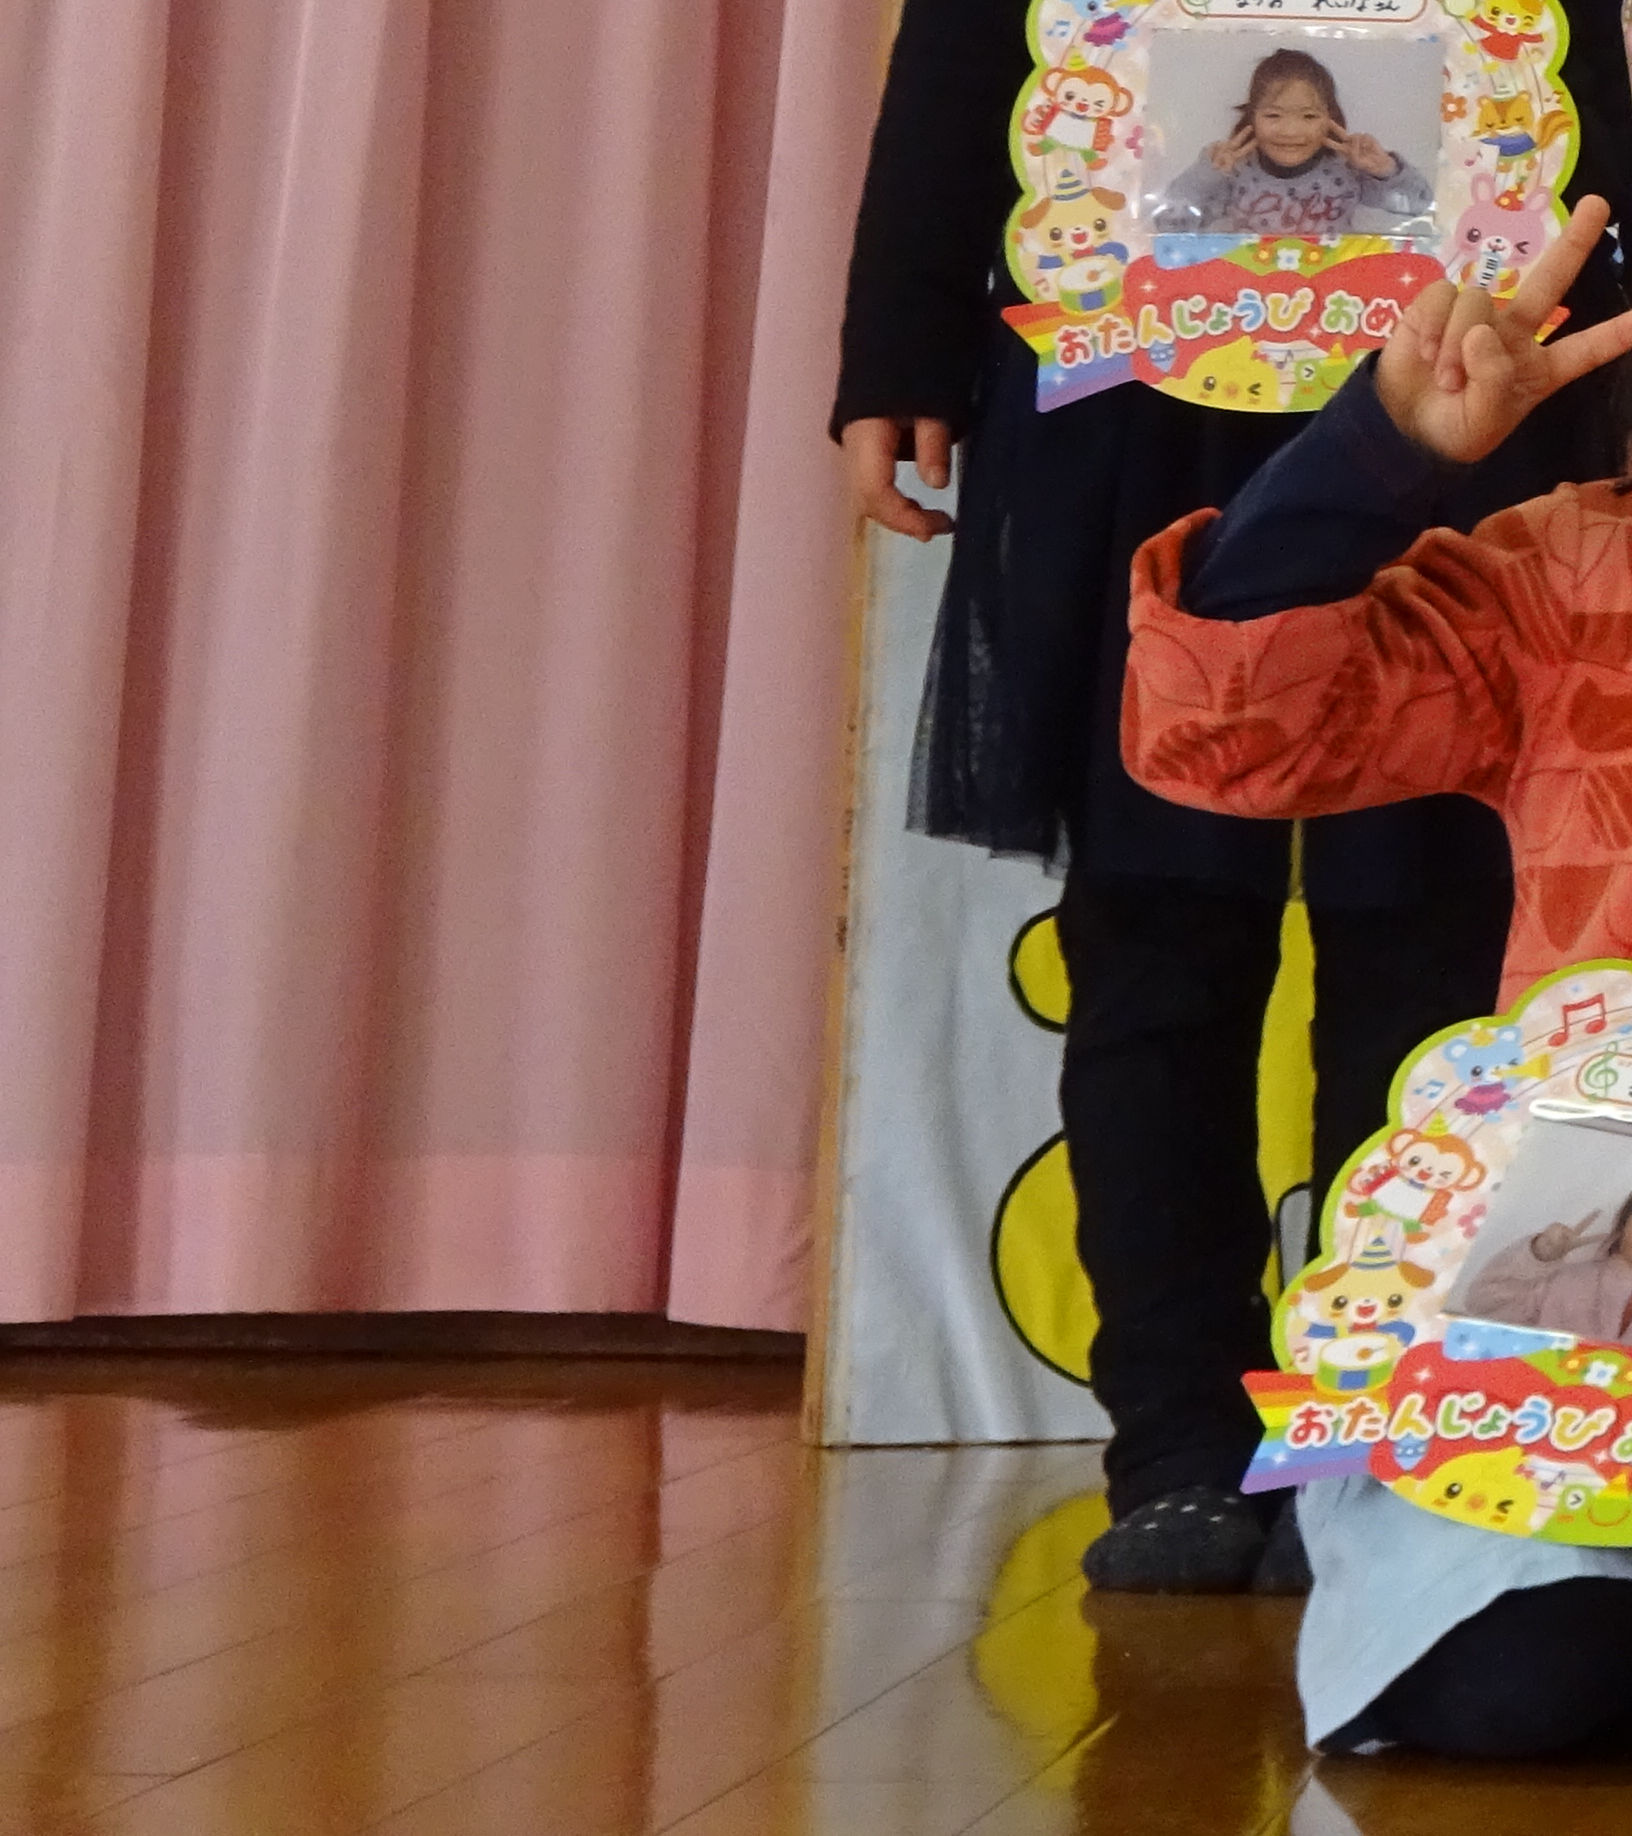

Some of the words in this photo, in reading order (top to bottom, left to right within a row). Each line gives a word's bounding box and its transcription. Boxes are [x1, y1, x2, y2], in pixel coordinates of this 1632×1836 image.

[1055, 283, 1315, 368] おたんじょうび
[1286, 1390, 1615, 1451] おたんじょうび
